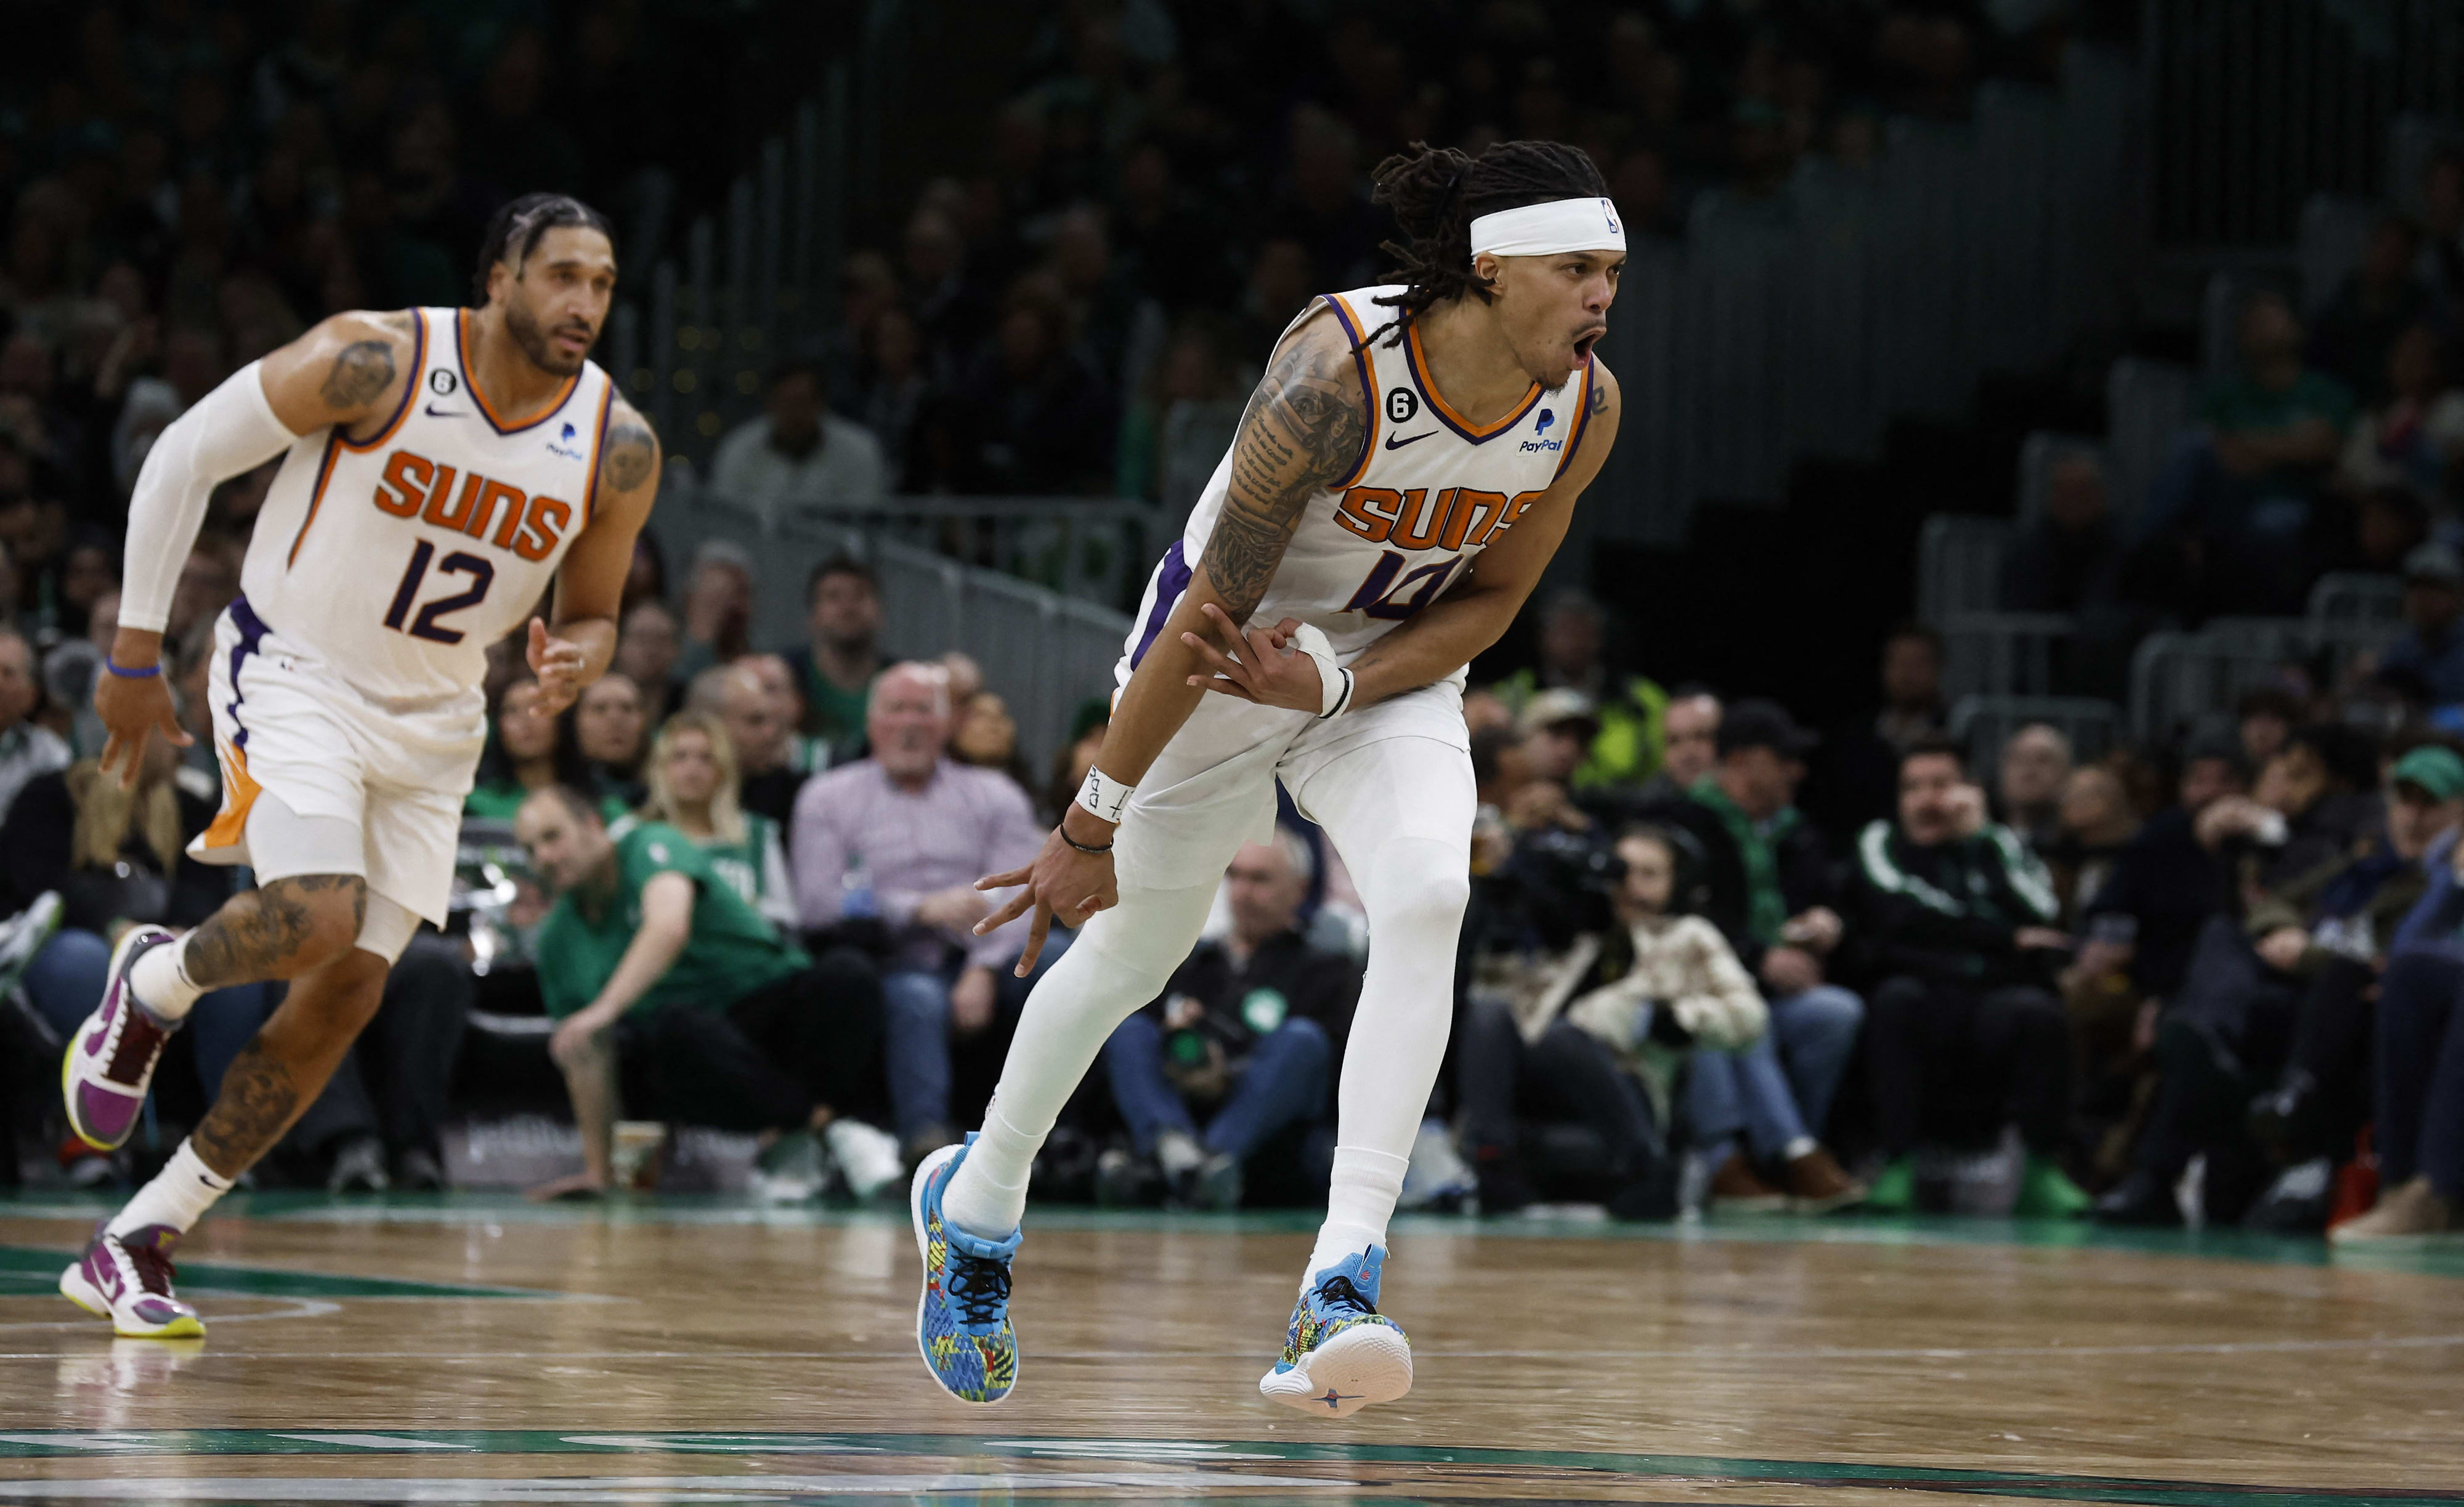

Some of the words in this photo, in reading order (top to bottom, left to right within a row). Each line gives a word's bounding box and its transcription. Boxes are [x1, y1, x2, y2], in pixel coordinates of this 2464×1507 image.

[1392, 392, 1410, 419] 6
[1519, 439, 1563, 453] PayPal
[373, 450, 572, 563] SUNS
[382, 536, 495, 645] 12
